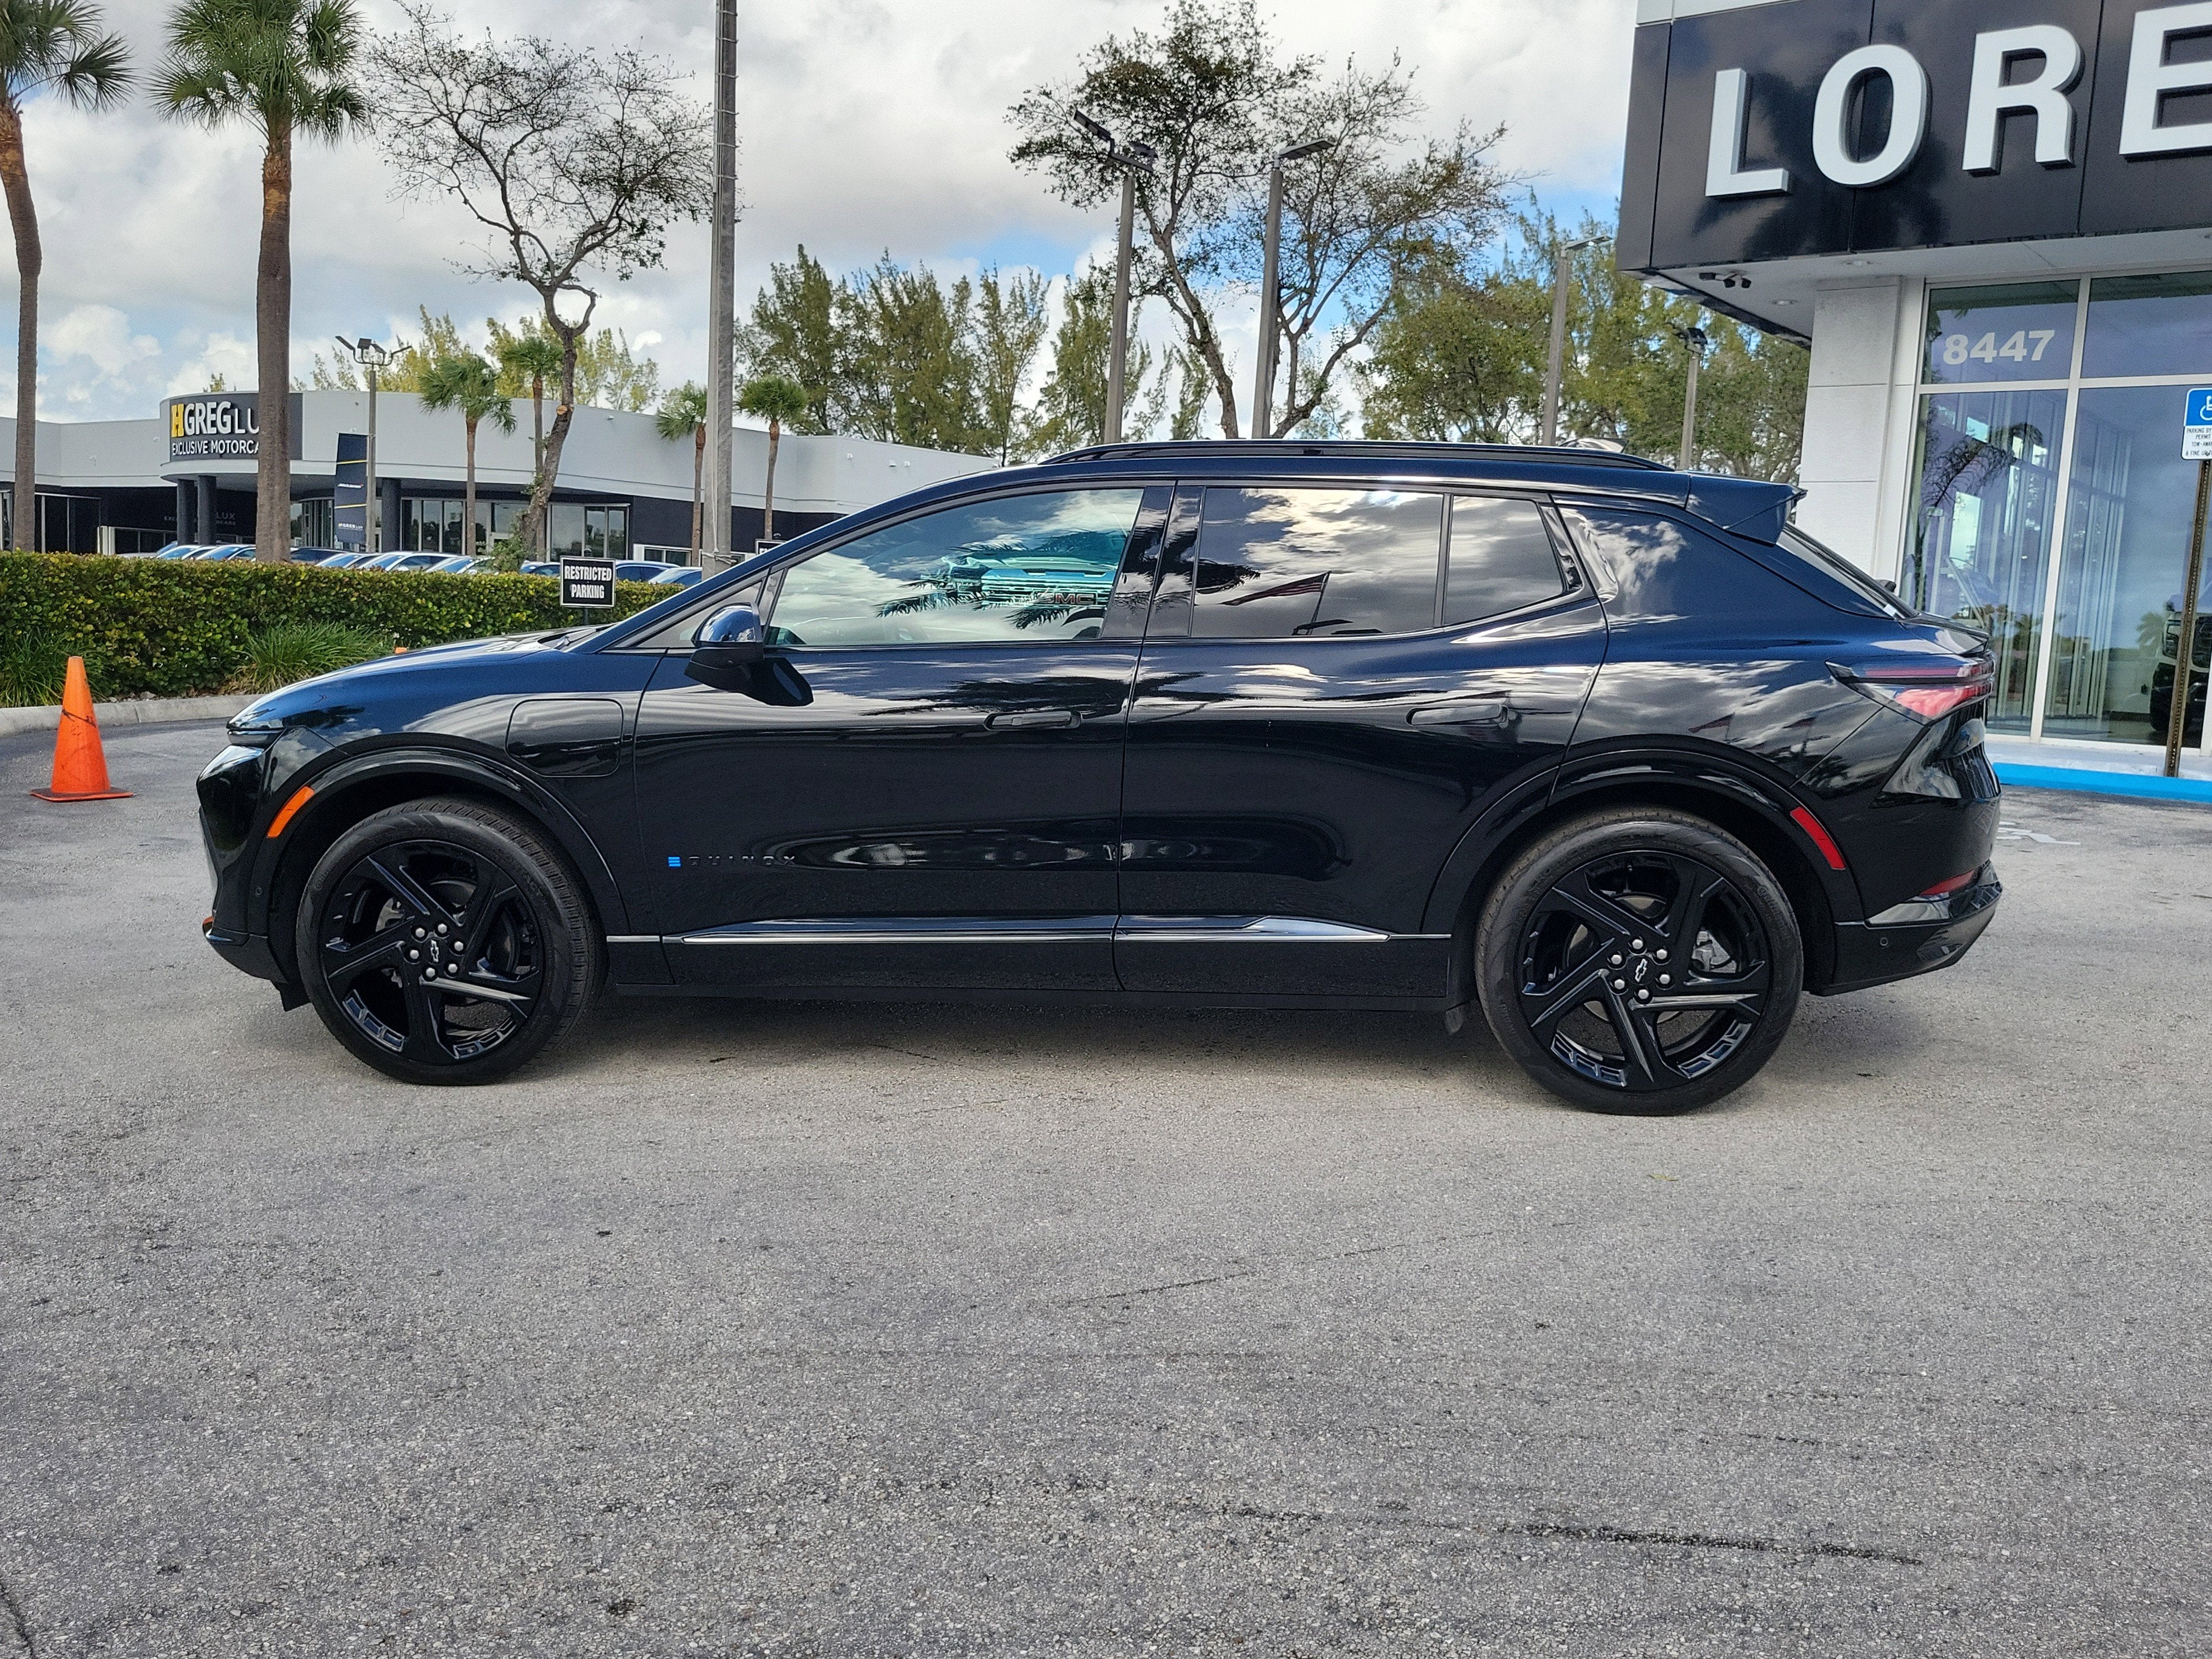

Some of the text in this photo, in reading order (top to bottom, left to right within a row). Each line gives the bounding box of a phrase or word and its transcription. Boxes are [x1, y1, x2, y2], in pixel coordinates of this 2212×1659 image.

[1943, 330, 2055, 365] 8447
[234, 408, 259, 434] LU
[172, 439, 259, 455] EXCLUSIVE MOTORCA
[564, 565, 612, 582] RESTRICTED
[571, 584, 605, 599] PARKING
